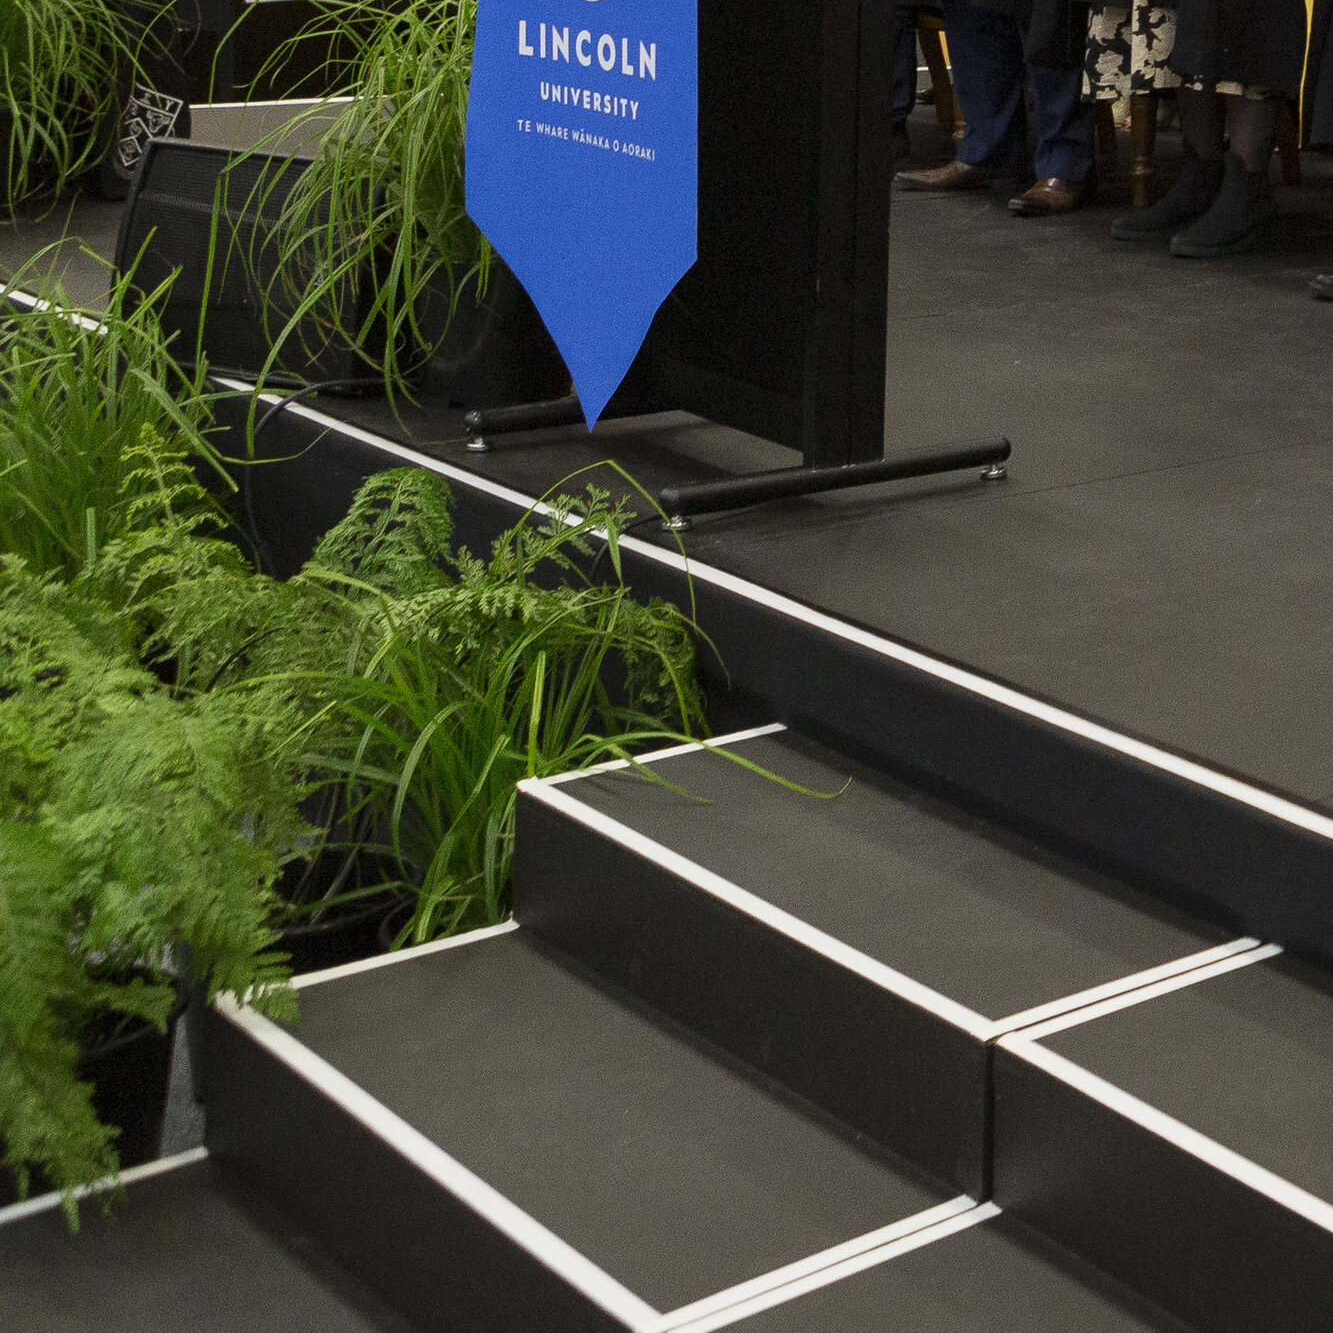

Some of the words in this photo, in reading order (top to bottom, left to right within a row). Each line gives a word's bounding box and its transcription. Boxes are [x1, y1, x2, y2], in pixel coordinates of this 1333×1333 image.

[518, 19, 657, 81] LINCOLN
[540, 81, 639, 120] UNIVERSITY
[517, 119, 531, 133] TE
[536, 121, 569, 140] WHARE
[571, 128, 610, 149] WĀNAKA
[613, 139, 620, 153] O
[622, 143, 656, 161] AORAKI
